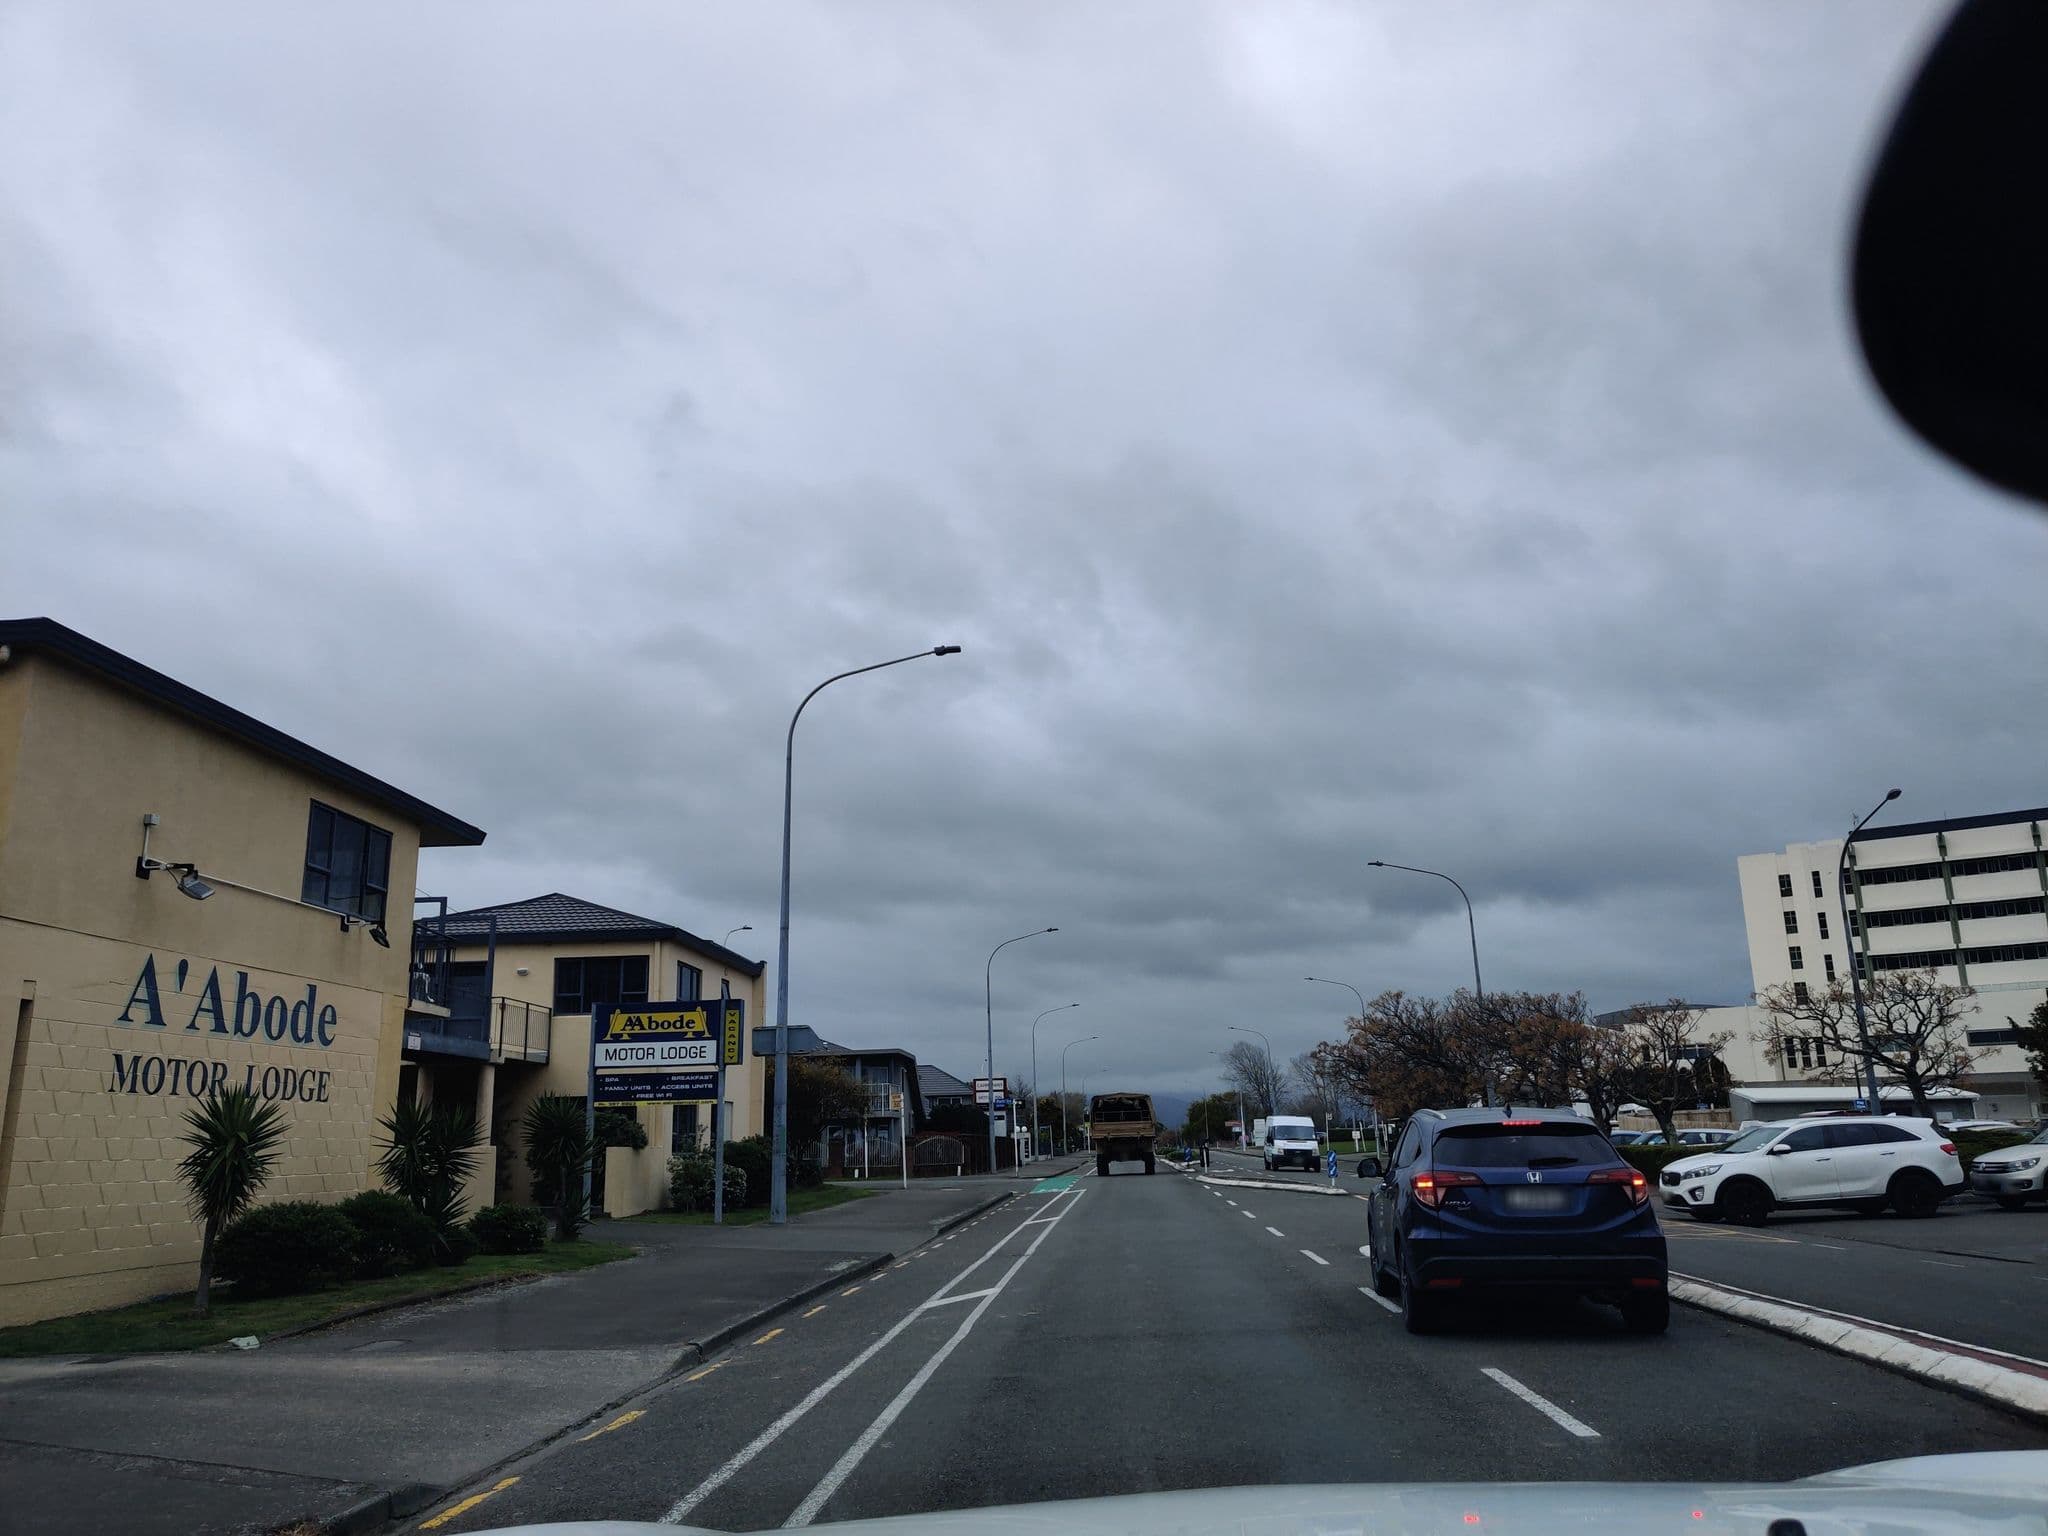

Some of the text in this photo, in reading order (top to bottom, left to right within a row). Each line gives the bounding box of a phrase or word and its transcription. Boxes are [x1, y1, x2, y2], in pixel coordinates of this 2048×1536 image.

[115, 953, 338, 1047] A'Abode
[605, 1045, 707, 1062] MOTOR LODGE
[728, 1012, 737, 1060] VACANCY
[108, 1053, 331, 1103] MOTOR LODGE
